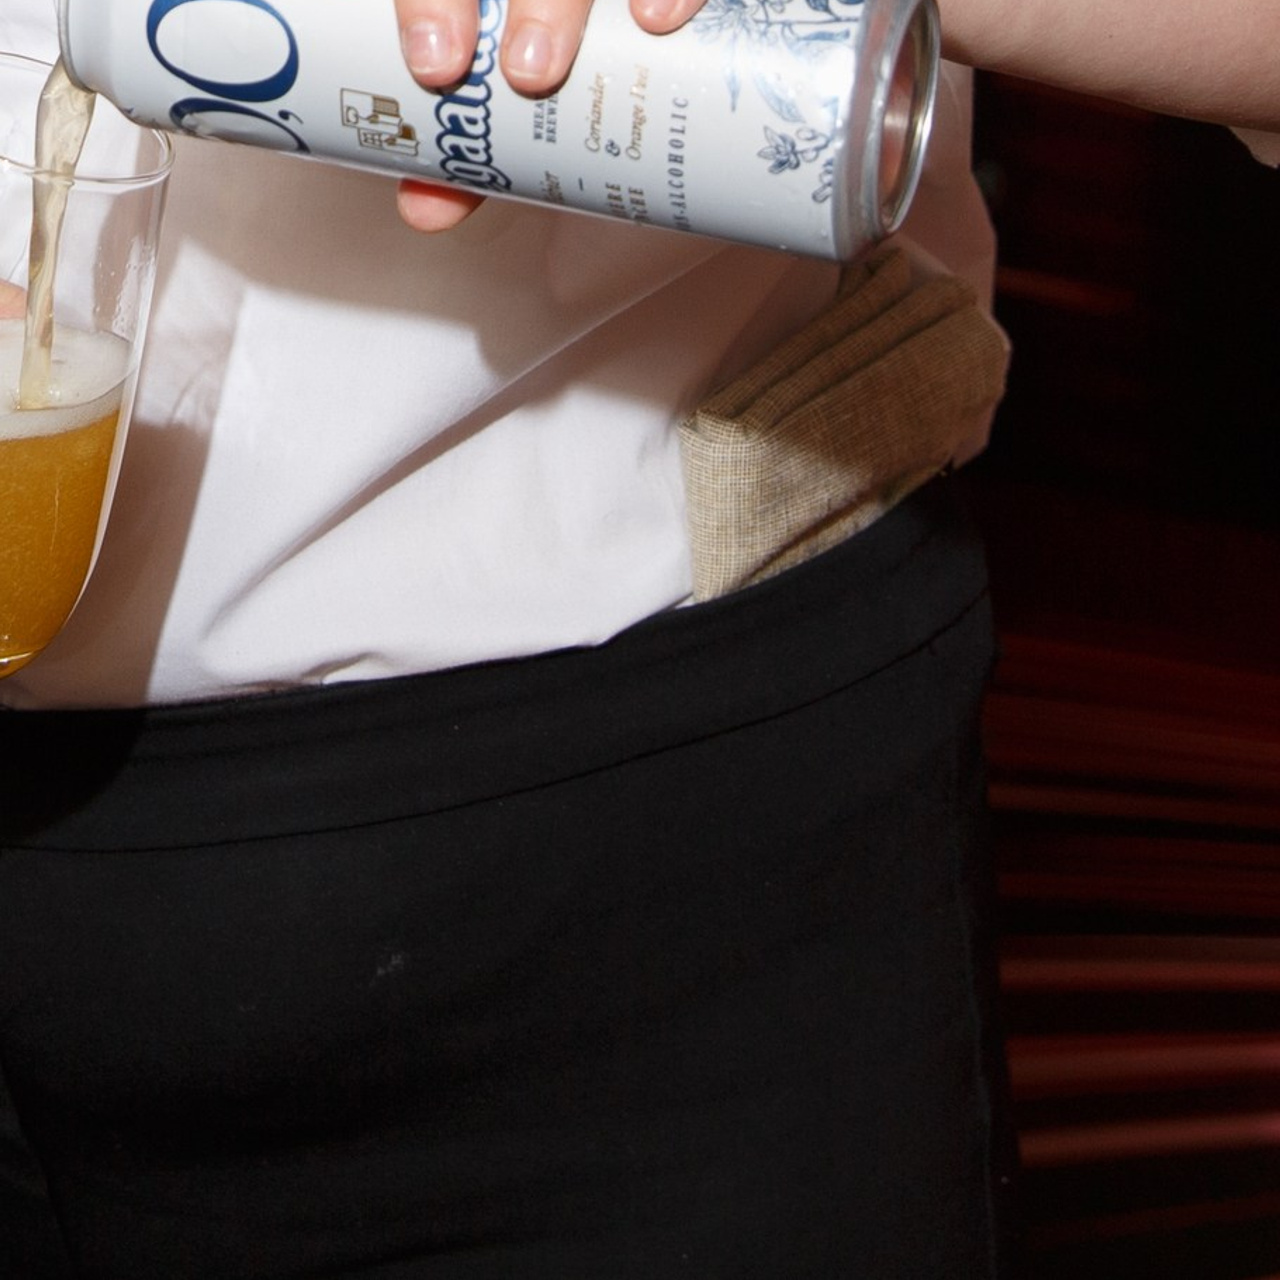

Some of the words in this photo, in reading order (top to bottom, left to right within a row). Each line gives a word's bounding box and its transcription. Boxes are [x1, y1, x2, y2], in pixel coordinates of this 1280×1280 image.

[532, 100, 545, 141] WHEA
[583, 71, 605, 154] Coriander
[625, 104, 647, 161] Orange
[604, 138, 621, 157] &
